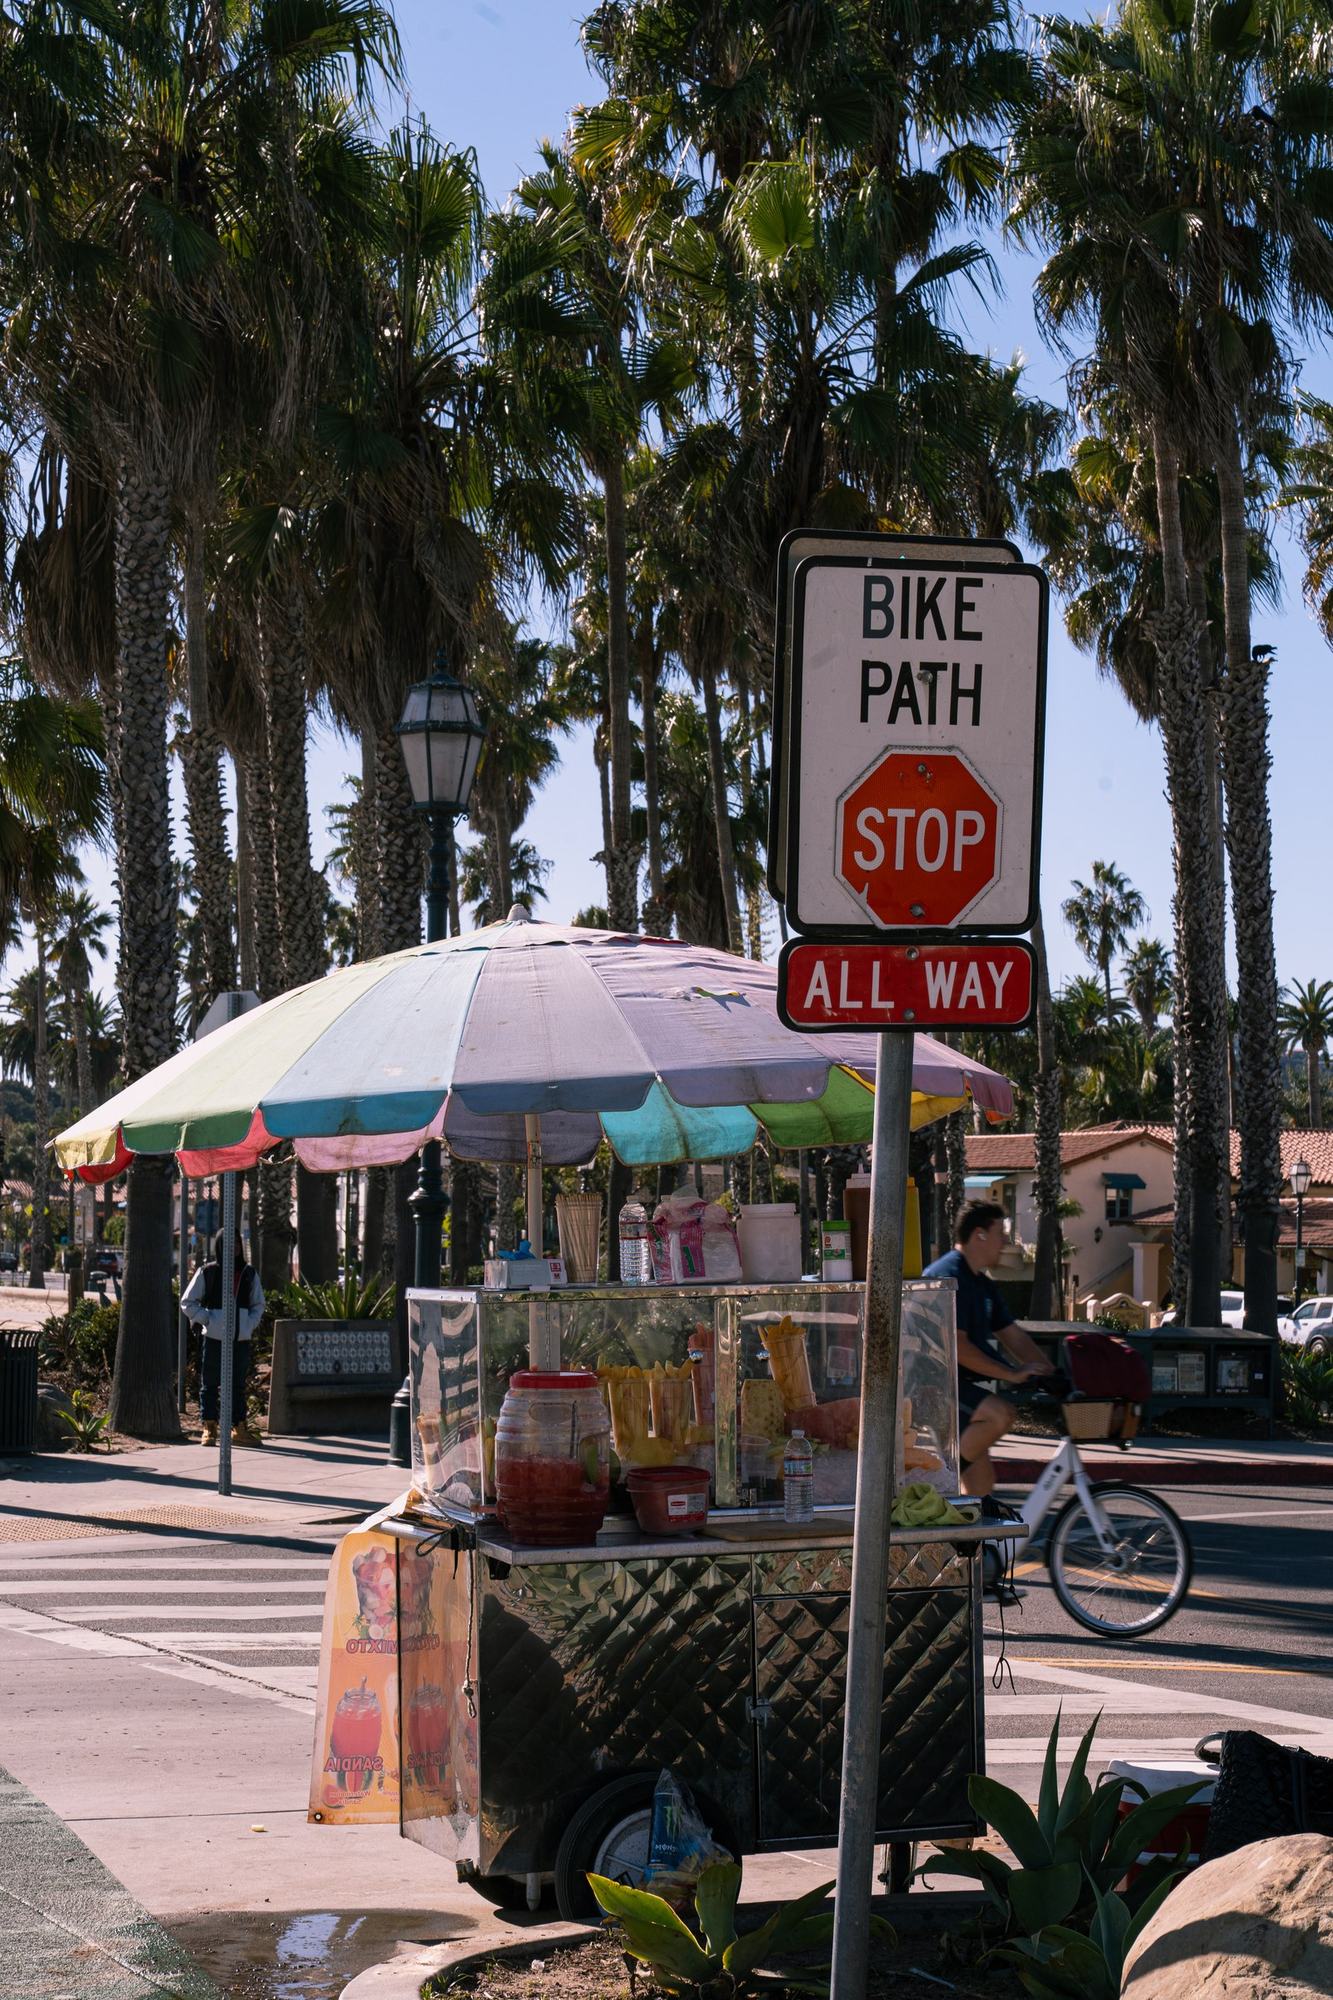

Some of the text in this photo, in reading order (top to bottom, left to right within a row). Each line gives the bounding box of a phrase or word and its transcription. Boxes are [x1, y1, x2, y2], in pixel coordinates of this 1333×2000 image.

[863, 575, 983, 641] BIKE
[859, 660, 983, 726] PATH
[853, 807, 986, 872] STOP
[803, 960, 1014, 1010] ALL WAY
